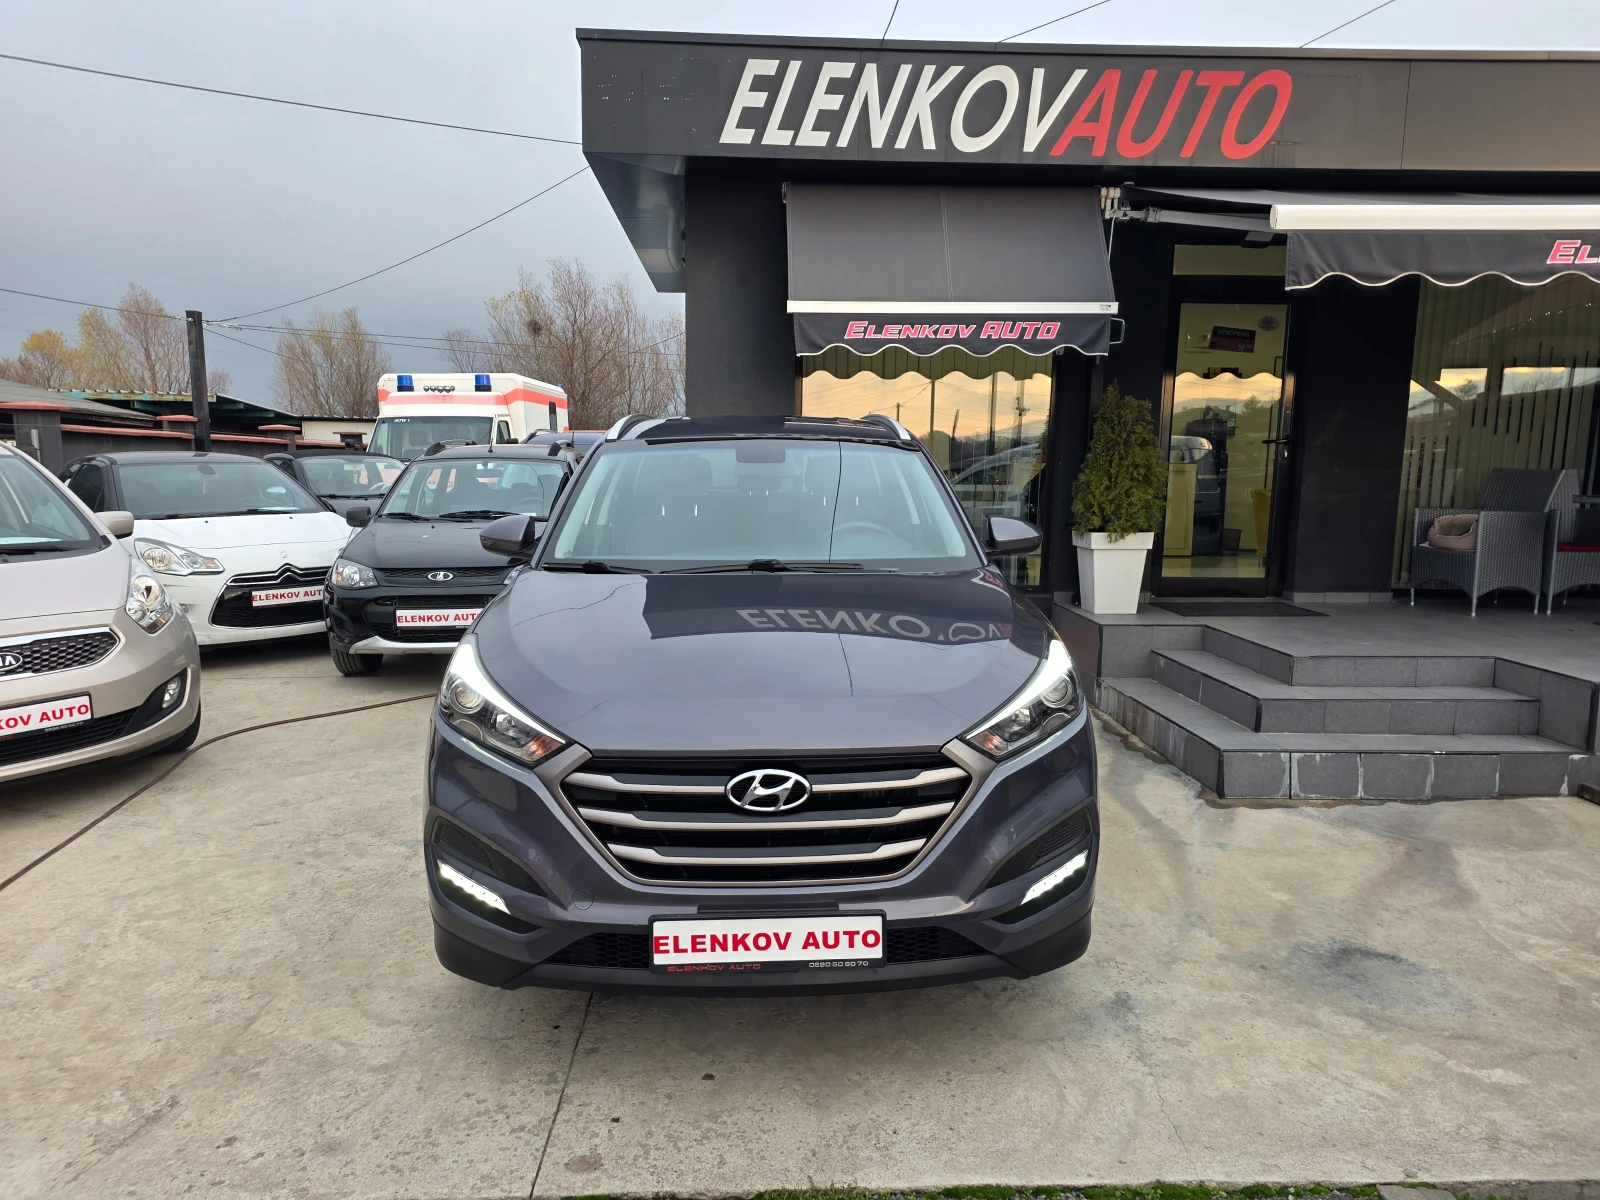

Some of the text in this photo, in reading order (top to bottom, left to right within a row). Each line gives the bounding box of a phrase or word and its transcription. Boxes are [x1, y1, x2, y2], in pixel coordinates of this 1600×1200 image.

[1546, 240, 1600, 264] EL
[844, 321, 1060, 339] ELENKOV AUTO
[251, 590, 302, 602] ELENKOV
[397, 612, 479, 623] ELENKOV AUT
[39, 704, 90, 724] AUTO
[653, 929, 881, 955] ELENKOV AUTO
